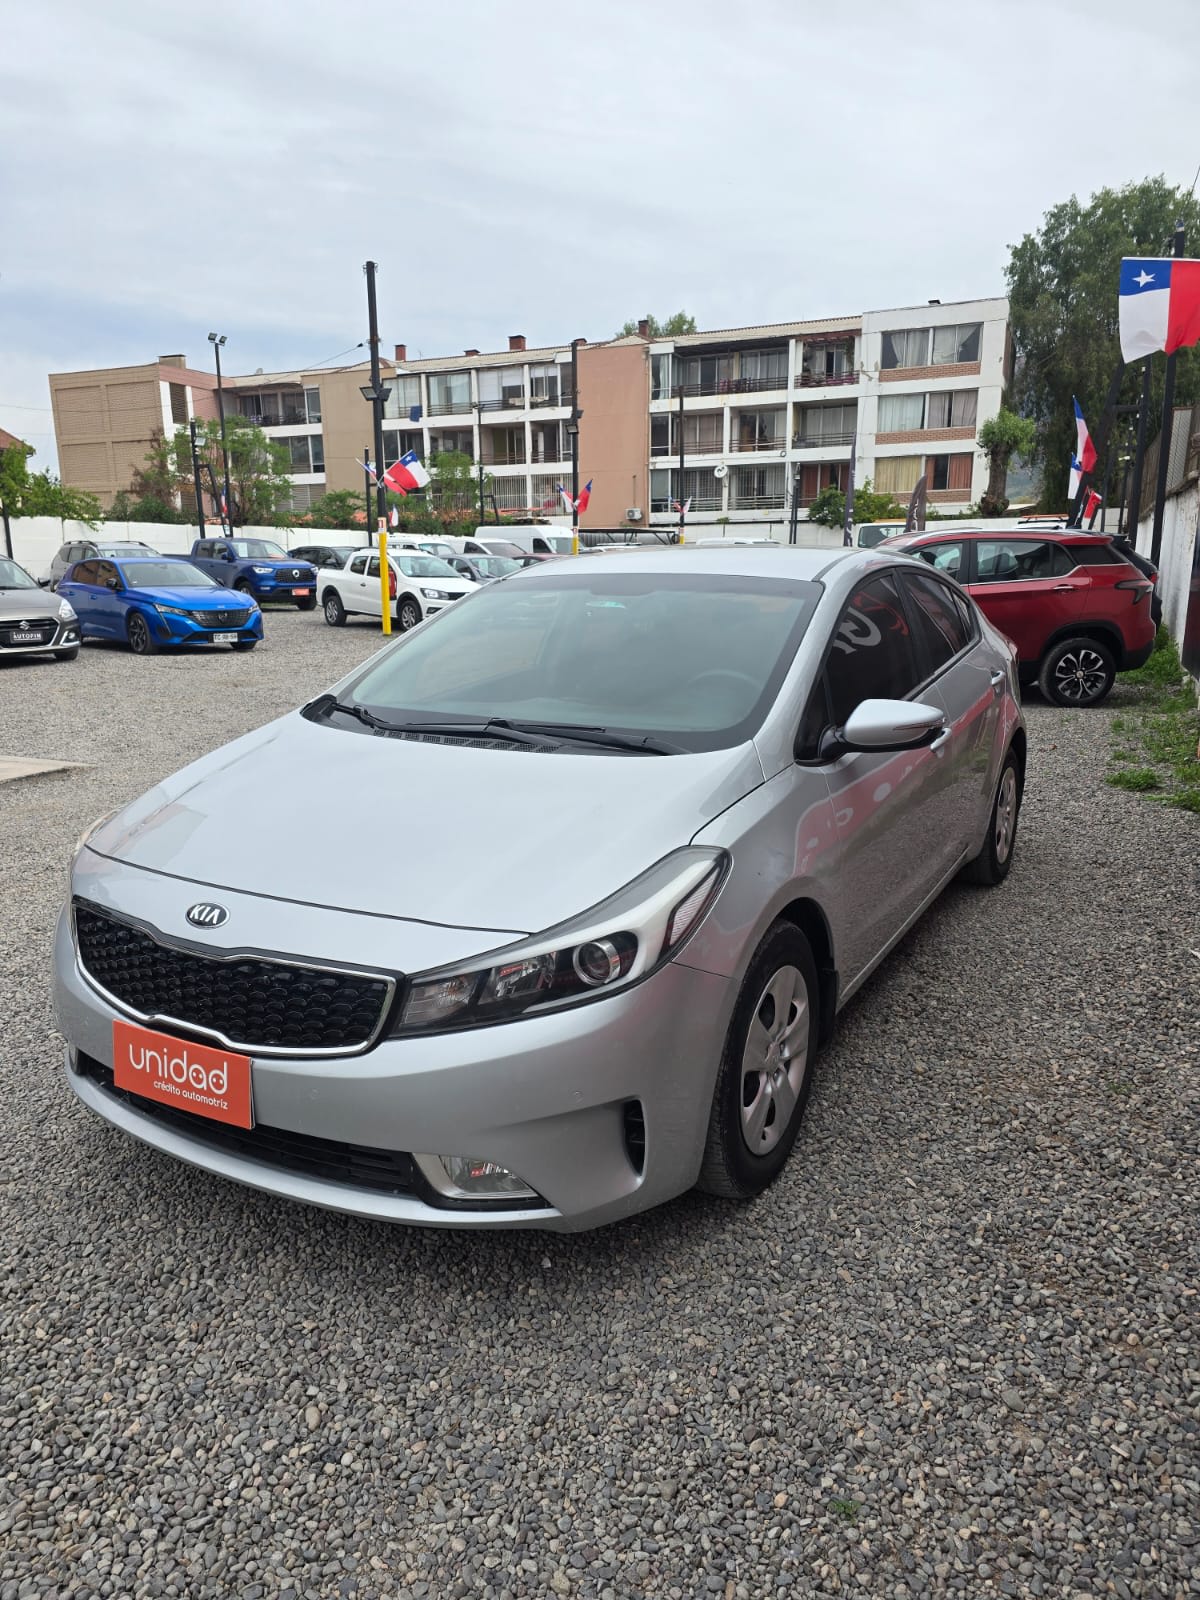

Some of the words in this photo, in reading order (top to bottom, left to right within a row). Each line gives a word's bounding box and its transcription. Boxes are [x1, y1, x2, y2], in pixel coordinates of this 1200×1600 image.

[189, 904, 221, 925] KIA
[128, 1043, 228, 1095] unidad
[153, 1079, 181, 1096] crédito
[182, 1089, 229, 1110] automotriz
